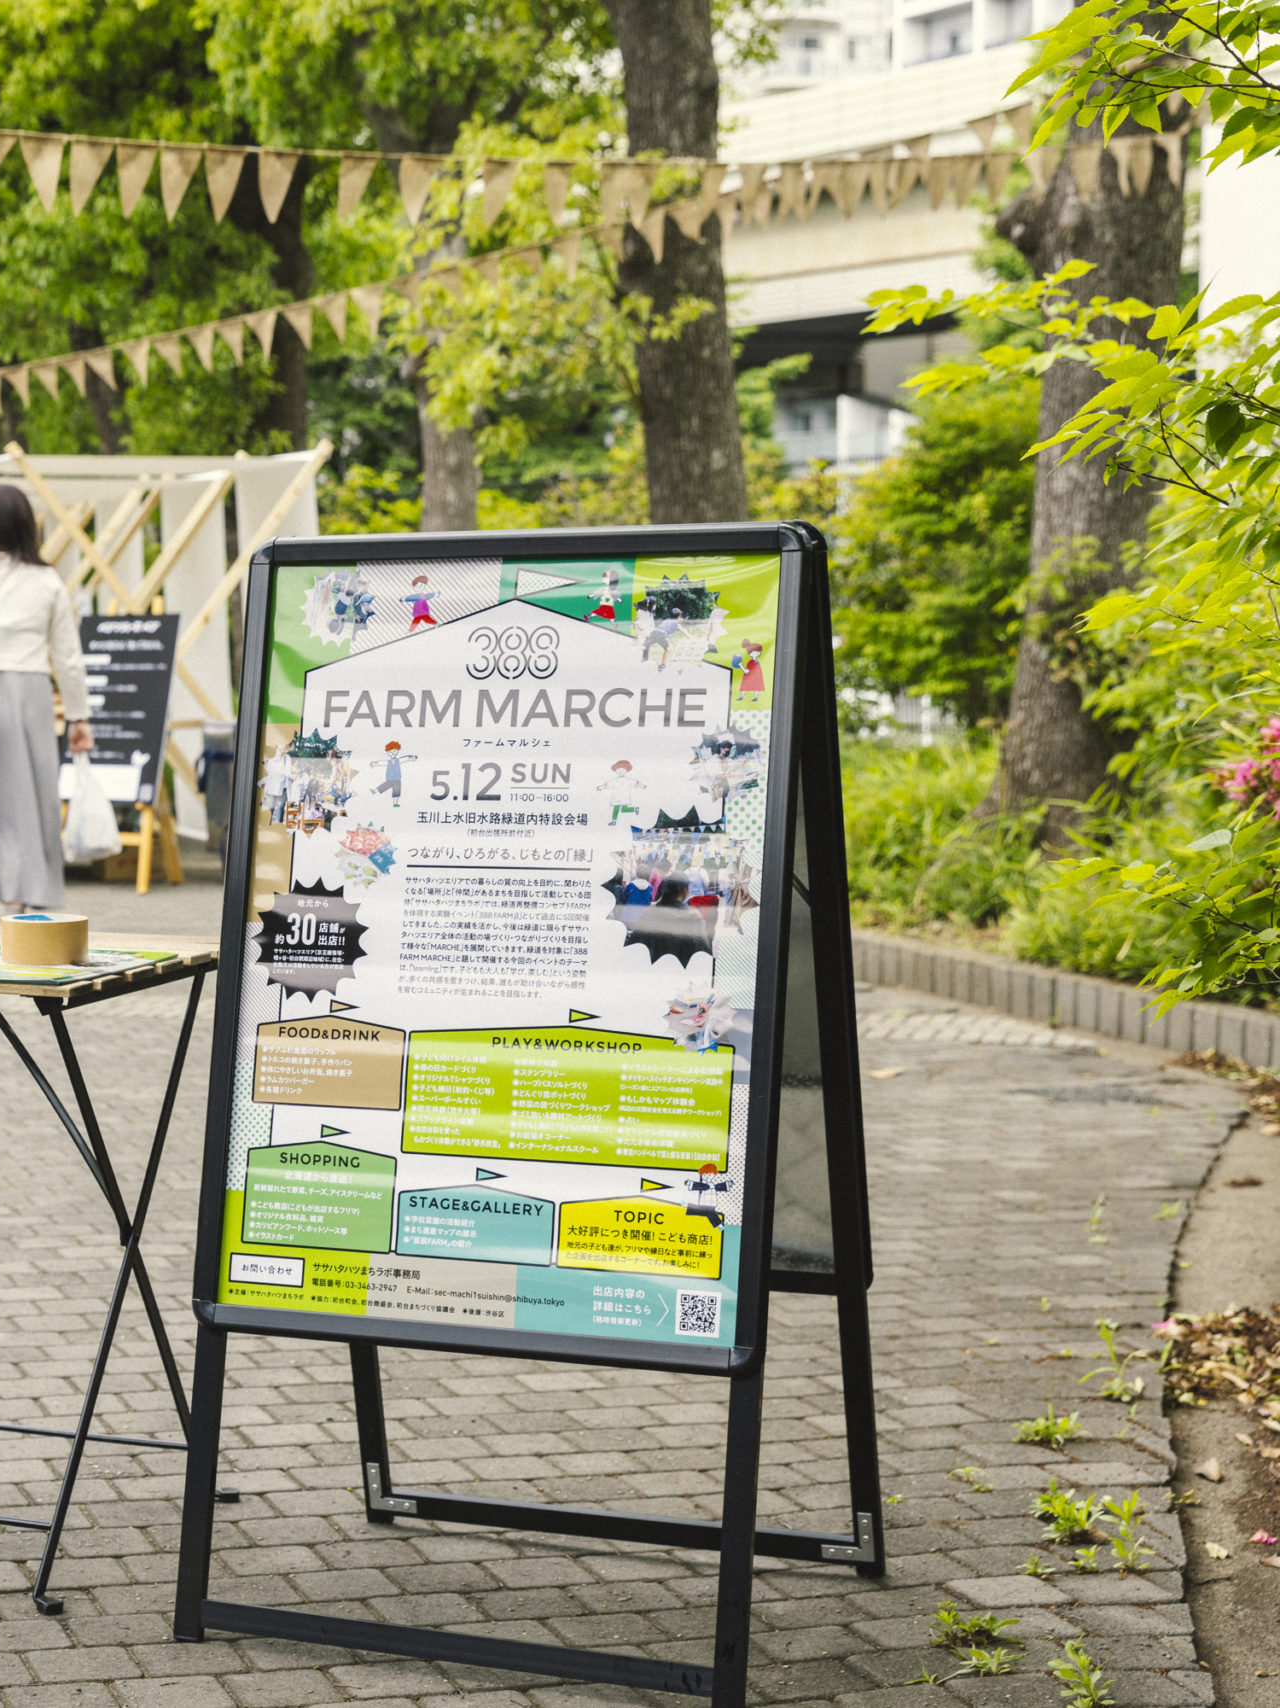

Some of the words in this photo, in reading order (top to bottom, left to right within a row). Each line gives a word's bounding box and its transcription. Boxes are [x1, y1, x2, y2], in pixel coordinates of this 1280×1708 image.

[466, 625, 559, 680] 388
[323, 689, 462, 728] FARM
[475, 687, 707, 728] MARCHE
[462, 737, 551, 748] ファームマルシェ
[510, 763, 572, 784] SUN
[430, 763, 502, 801] 5.12
[417, 811, 588, 827] 玉川上水旧水路緑道内特設会場
[279, 1027, 381, 1041] FOOD&DRINK
[492, 1037, 642, 1055] PLAY&WORKSHOP
[280, 1152, 360, 1168] SHOPPING
[409, 1195, 544, 1216] STAGE&GALLERY
[614, 1210, 665, 1225] TOPIC
[241, 1264, 293, 1276] お問い合わせ
[312, 1263, 421, 1280] ササハタハツまちラボ事務局
[592, 1285, 646, 1300] 出店内容の
[592, 1300, 652, 1316] 詳細はこちら
